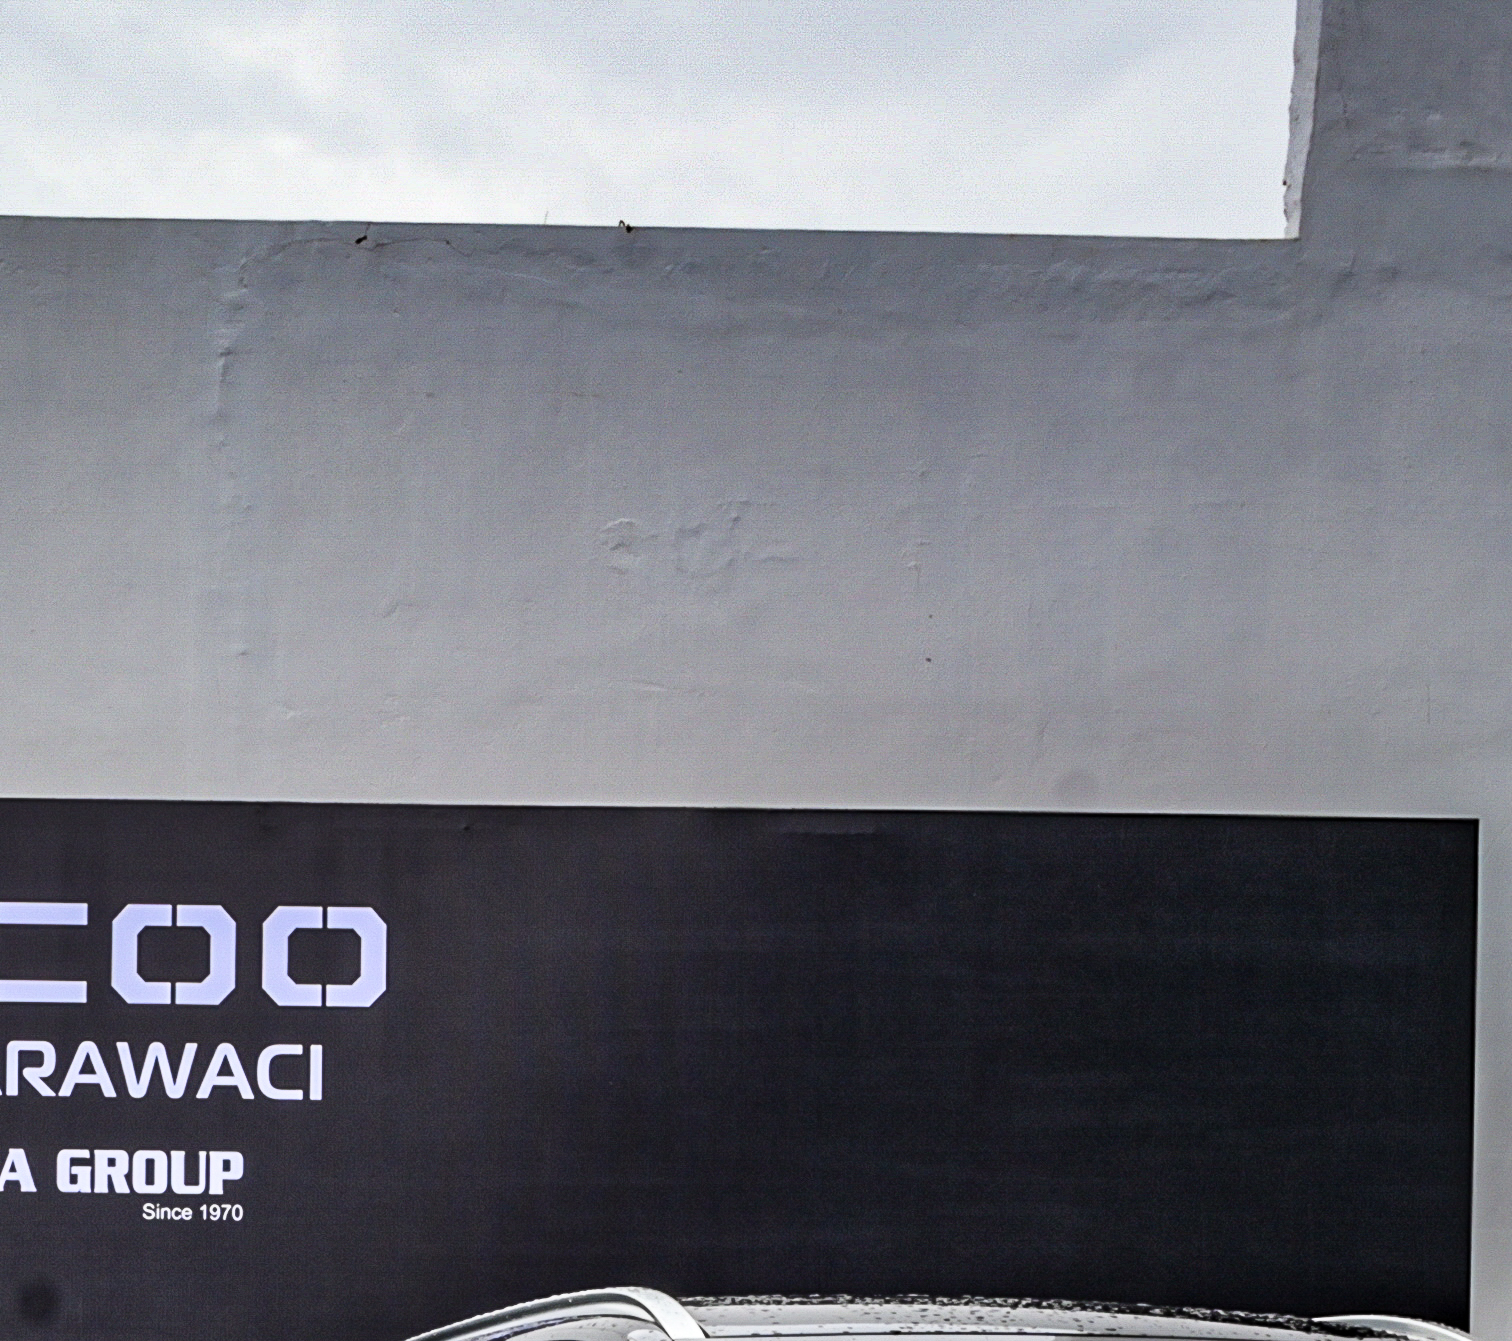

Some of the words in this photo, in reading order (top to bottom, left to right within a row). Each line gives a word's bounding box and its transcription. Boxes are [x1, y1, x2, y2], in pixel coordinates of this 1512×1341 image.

[55, 1148, 245, 1196] GROUP
[141, 1203, 193, 1222] Since
[198, 1204, 244, 1222] 1970
